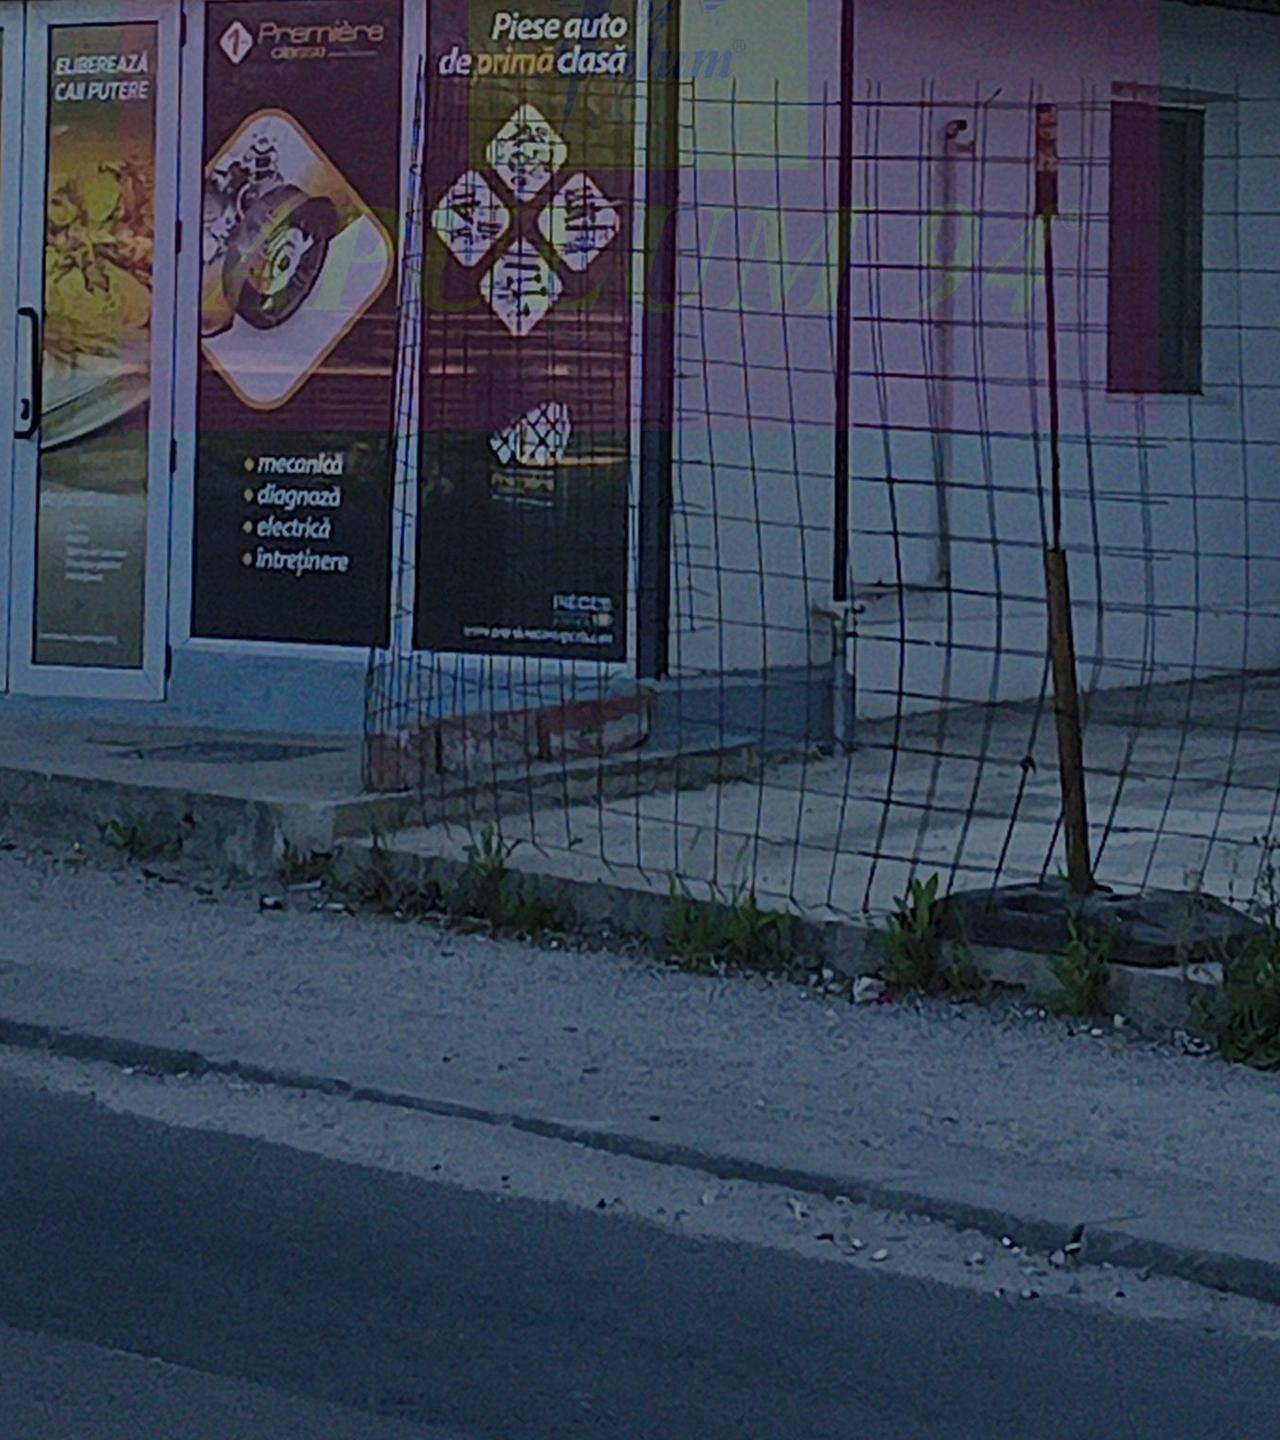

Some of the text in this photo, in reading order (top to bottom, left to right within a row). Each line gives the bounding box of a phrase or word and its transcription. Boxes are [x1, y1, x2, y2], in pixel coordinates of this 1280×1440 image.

[491, 12, 628, 40] Piese auto
[439, 44, 628, 80] de primă clasă
[87, 80, 149, 101] PUTERE
[257, 452, 343, 475] mecanică
[257, 483, 341, 510] diagnoză
[257, 515, 332, 539] electrică
